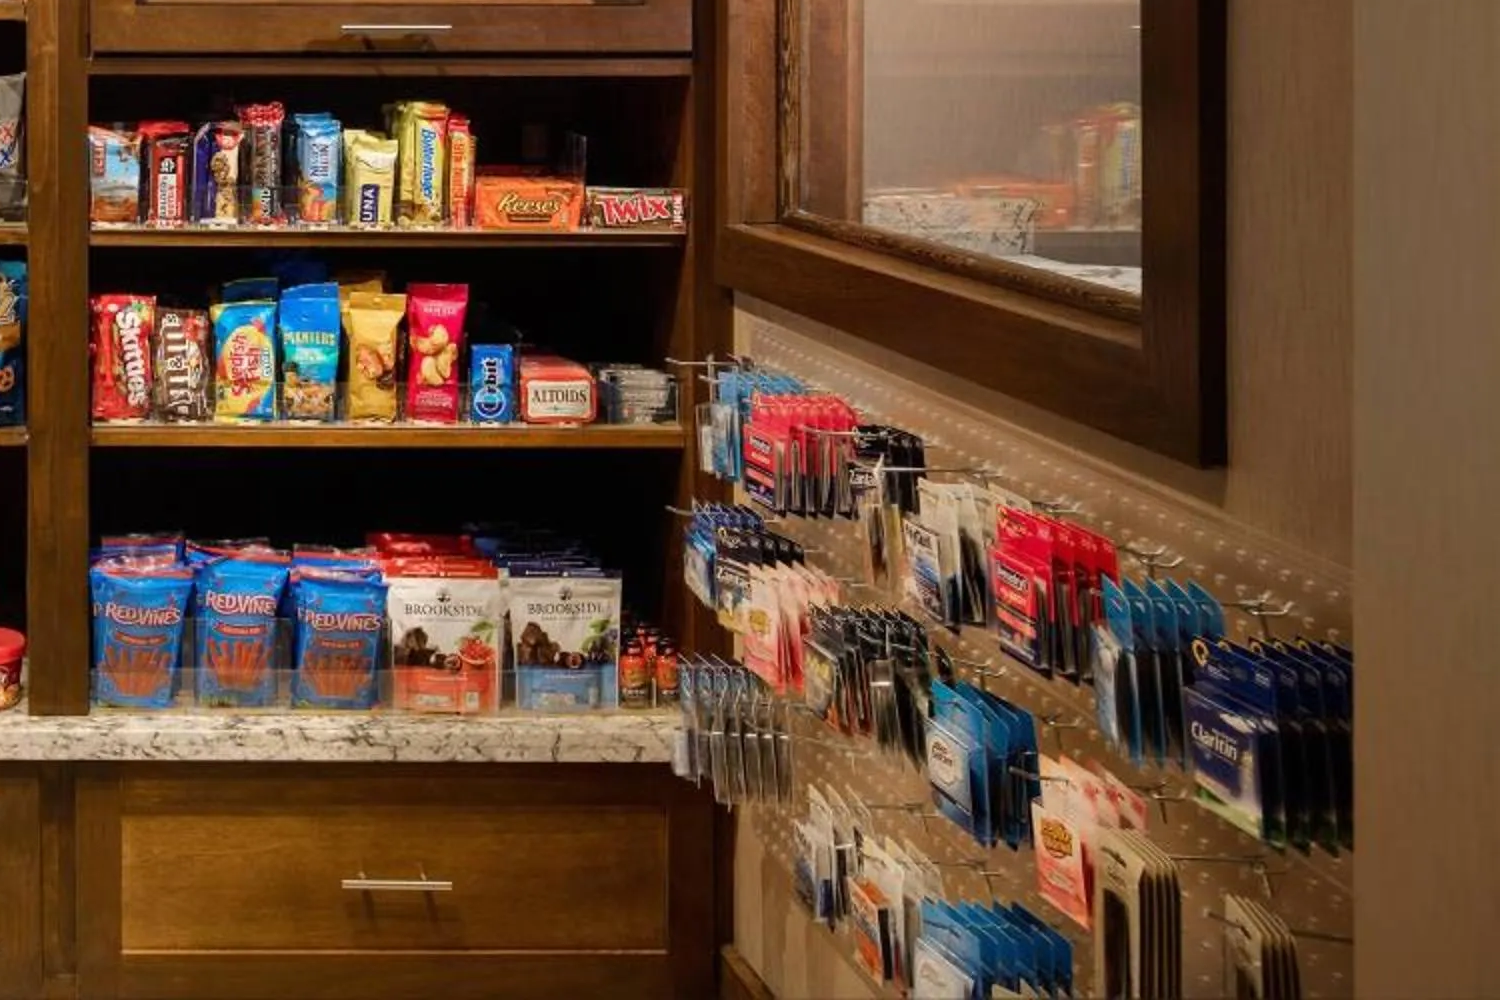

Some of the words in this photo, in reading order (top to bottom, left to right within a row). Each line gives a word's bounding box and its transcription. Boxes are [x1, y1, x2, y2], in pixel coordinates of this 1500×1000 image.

[362, 188, 375, 222] UNA
[532, 388, 587, 404] ALTOIDS
[1191, 721, 1237, 761] Claritin
